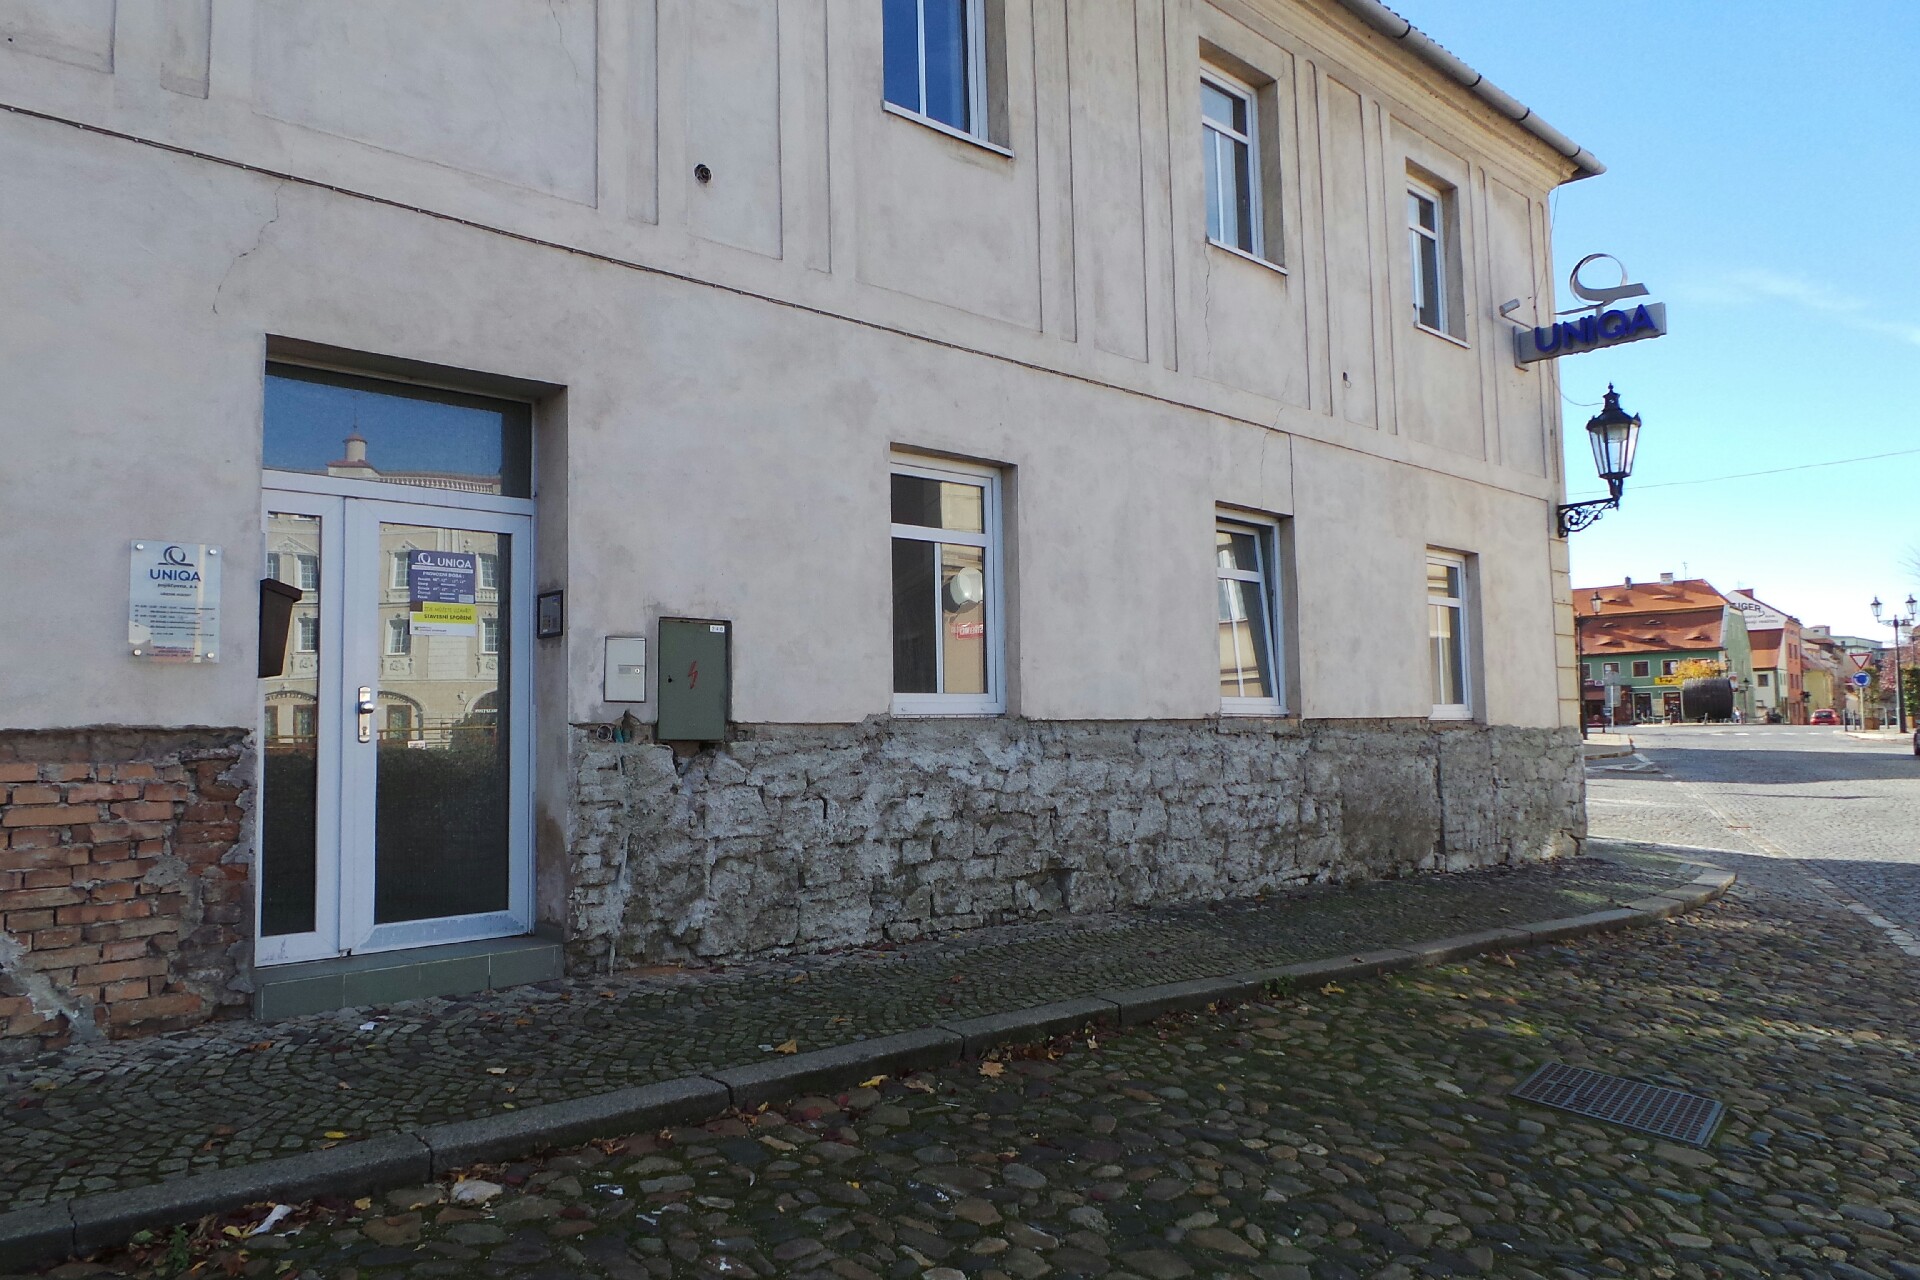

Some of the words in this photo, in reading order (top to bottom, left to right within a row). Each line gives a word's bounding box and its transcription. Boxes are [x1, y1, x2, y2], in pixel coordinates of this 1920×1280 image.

[1535, 304, 1659, 352] UNIQA
[437, 557, 472, 569] UNIQA
[149, 568, 201, 582] UNIQA
